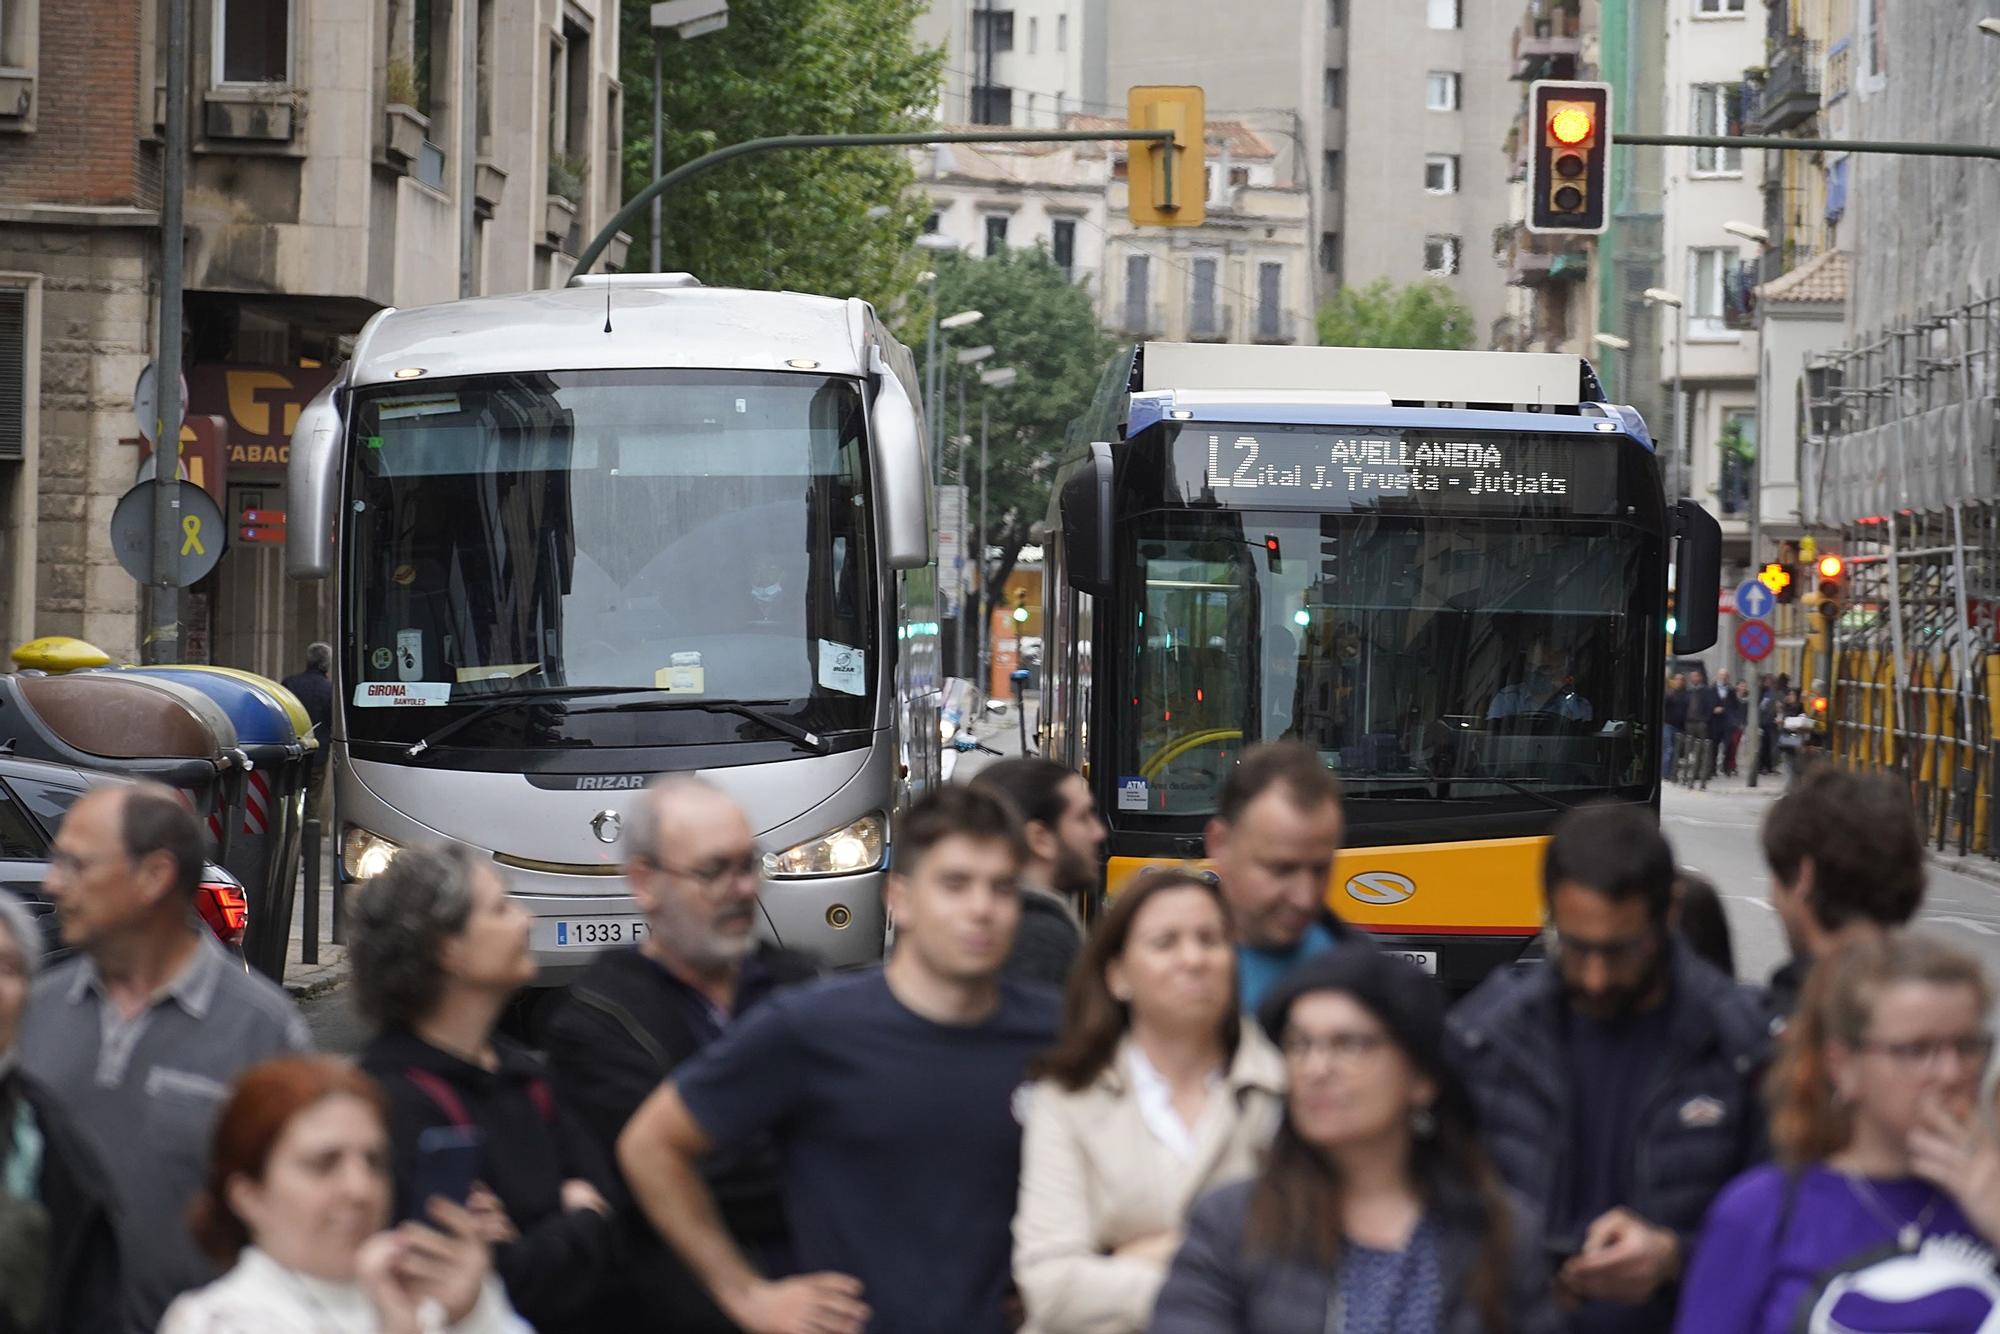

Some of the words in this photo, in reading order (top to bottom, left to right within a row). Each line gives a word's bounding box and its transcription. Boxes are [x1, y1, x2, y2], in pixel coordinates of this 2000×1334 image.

[226, 445, 290, 464] ABAC
[1207, 435, 1260, 488] L2
[1331, 439, 1502, 468] AVELLANEDA
[1258, 464, 1301, 487] ital
[1310, 465, 1333, 490] J.
[1342, 466, 1440, 491] Trueta
[1468, 470, 1567, 496] Jutjats
[368, 685, 406, 696] GIRONA
[576, 776, 644, 789] IRIZAR
[1126, 781, 1146, 791] ATM
[576, 923, 622, 942] 1333
